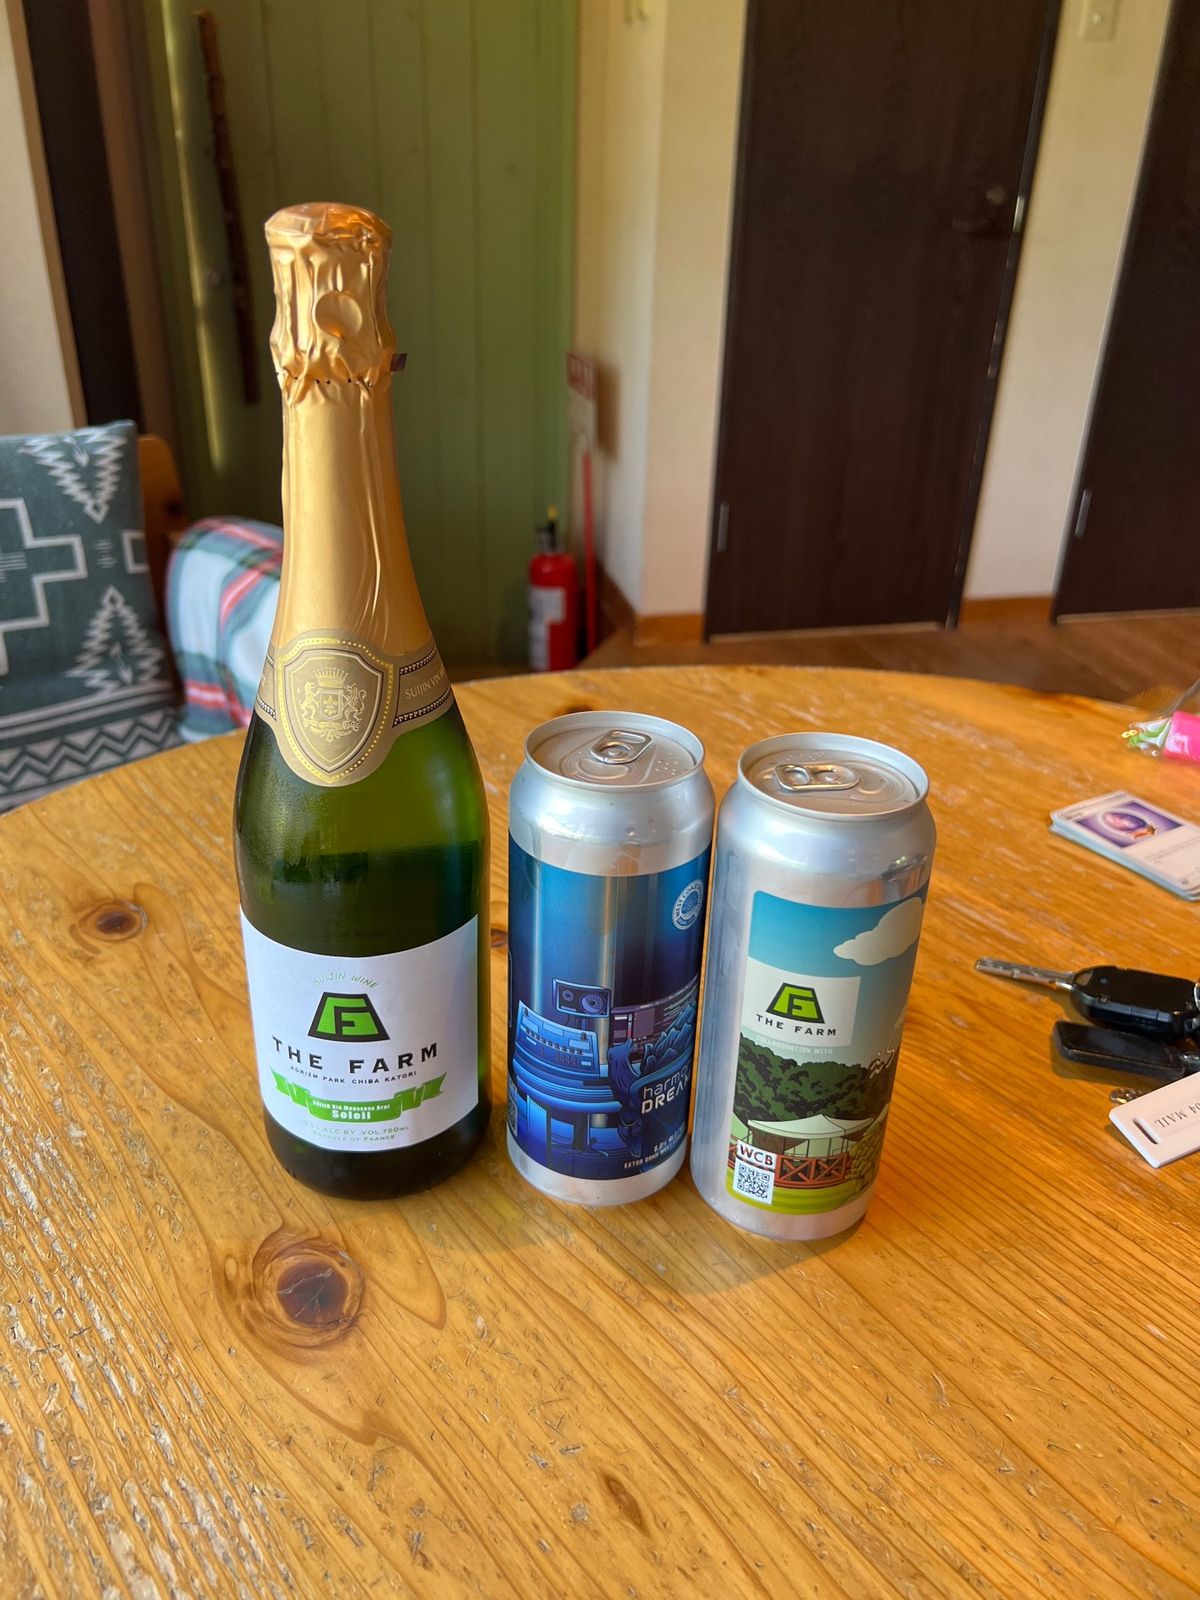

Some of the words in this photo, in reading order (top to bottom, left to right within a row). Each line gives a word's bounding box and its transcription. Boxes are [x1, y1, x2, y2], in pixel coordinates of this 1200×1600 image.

[351, 975, 378, 988] WINE
[756, 1013, 784, 1030] THE
[794, 1025, 837, 1036] FARM
[271, 1035, 323, 1071] THE
[348, 1042, 438, 1074] FARM
[322, 1076, 345, 1084] PARK
[384, 1070, 417, 1083] KATORI
[1153, 1110, 1188, 1128] MAIL
[739, 1144, 774, 1166] WCB
